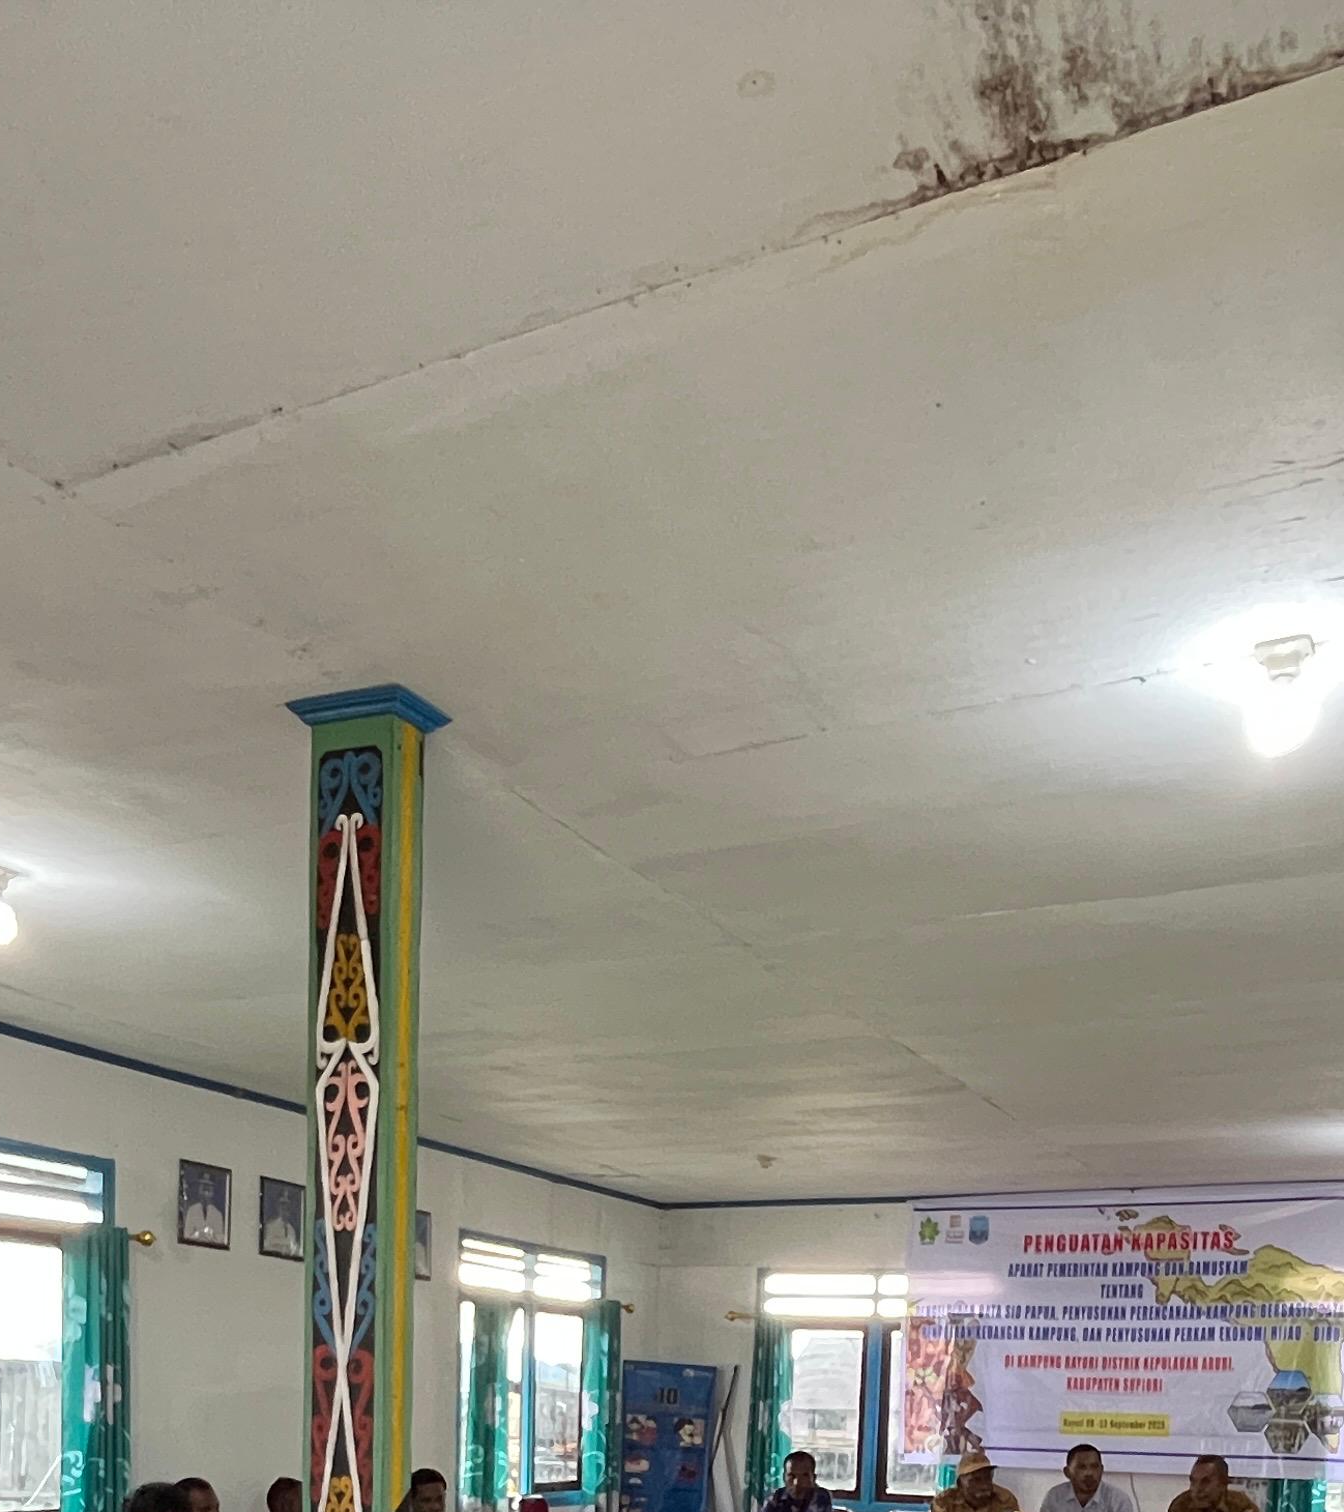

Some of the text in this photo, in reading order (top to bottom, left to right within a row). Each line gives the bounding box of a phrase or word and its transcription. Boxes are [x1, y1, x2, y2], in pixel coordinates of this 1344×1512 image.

[1023, 1231, 1234, 1254] PENGUATAN KAPASITAS
[1008, 1263, 1044, 1278] APARAT
[1047, 1263, 1108, 1278] PEMERINTAH
[1111, 1261, 1160, 1277] KAMPUNG
[1101, 1284, 1143, 1299] TENTANG
[1062, 1306, 1126, 1321] PENYUSUNAN
[1130, 1306, 1202, 1320] PERENCANAAN
[1206, 1304, 1256, 1319] KAMPUNG
[1083, 1327, 1102, 1342] DAN
[1106, 1327, 1170, 1342] PENYUSUNAN
[1017, 1355, 1061, 1369] KAMPUNG
[1066, 1377, 1120, 1392] KABUPATEN
